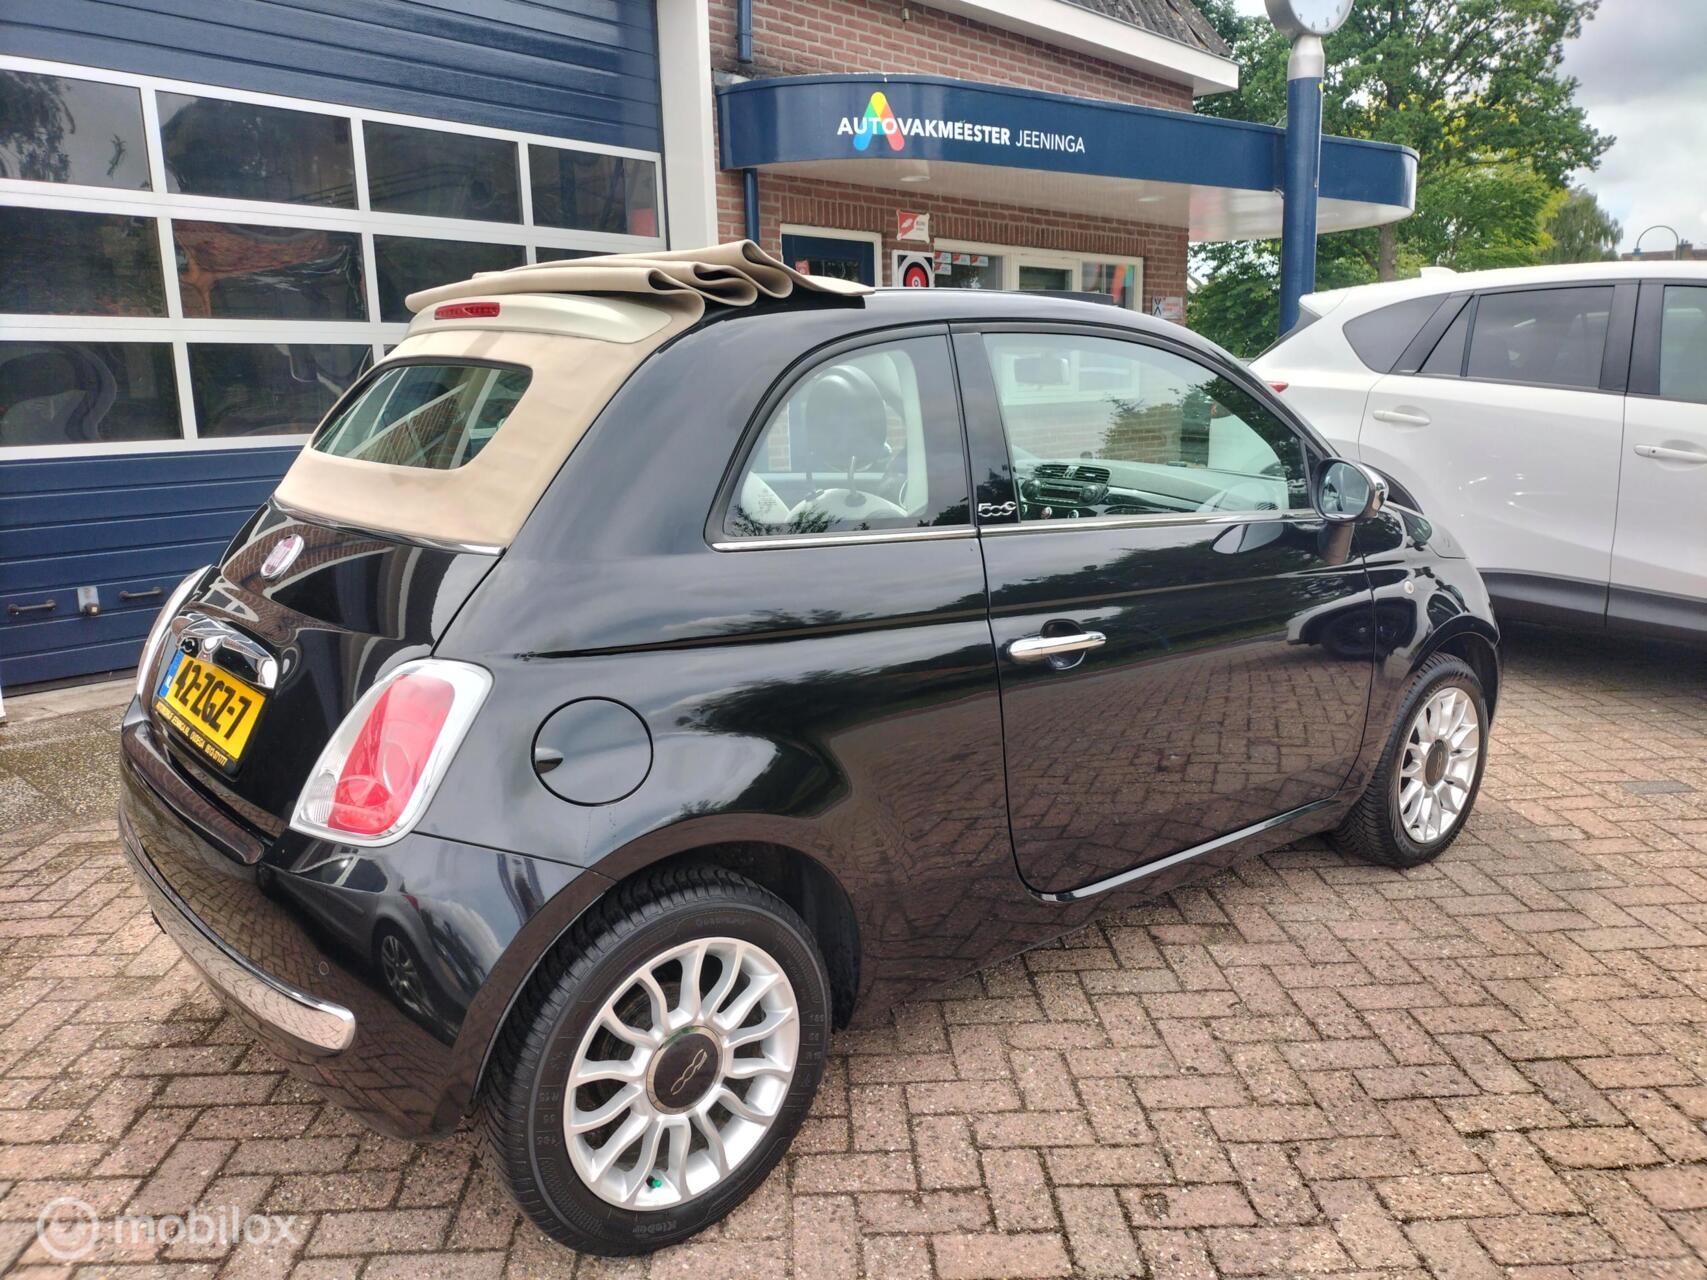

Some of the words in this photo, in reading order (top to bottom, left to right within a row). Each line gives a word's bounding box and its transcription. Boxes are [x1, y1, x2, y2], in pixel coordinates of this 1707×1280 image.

[837, 117, 1010, 145] AUTOVAKMEESTER
[1015, 130, 1085, 153] JEENINGA
[174, 660, 252, 740] 42-ZGZ-7
